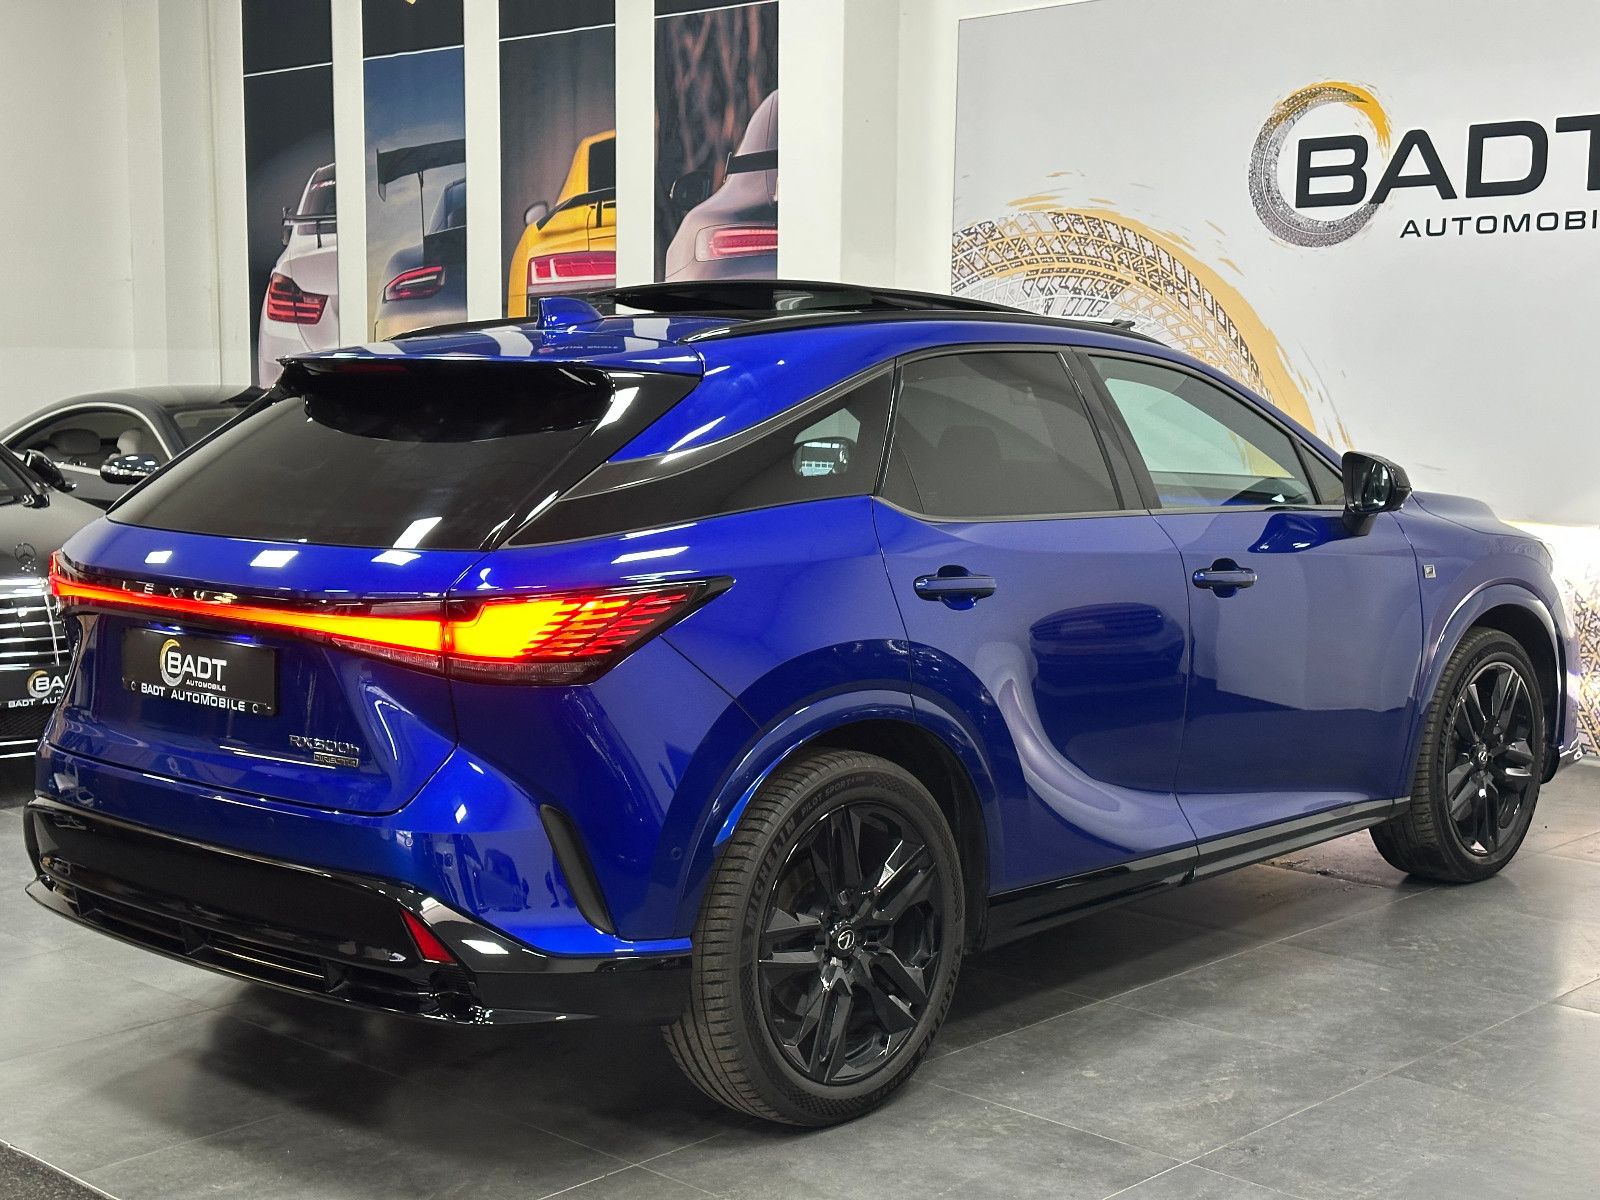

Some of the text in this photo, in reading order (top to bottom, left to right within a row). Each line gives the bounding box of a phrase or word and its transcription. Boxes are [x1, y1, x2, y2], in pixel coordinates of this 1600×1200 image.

[1295, 114, 1600, 209] BADT
[121, 580, 238, 605] LEXUS
[167, 651, 228, 682] BADT
[36, 674, 69, 691] BA
[186, 679, 227, 692] AUTOMOBILE
[8, 698, 35, 708] BADT
[141, 682, 246, 712] BADT AUTOMOBILE
